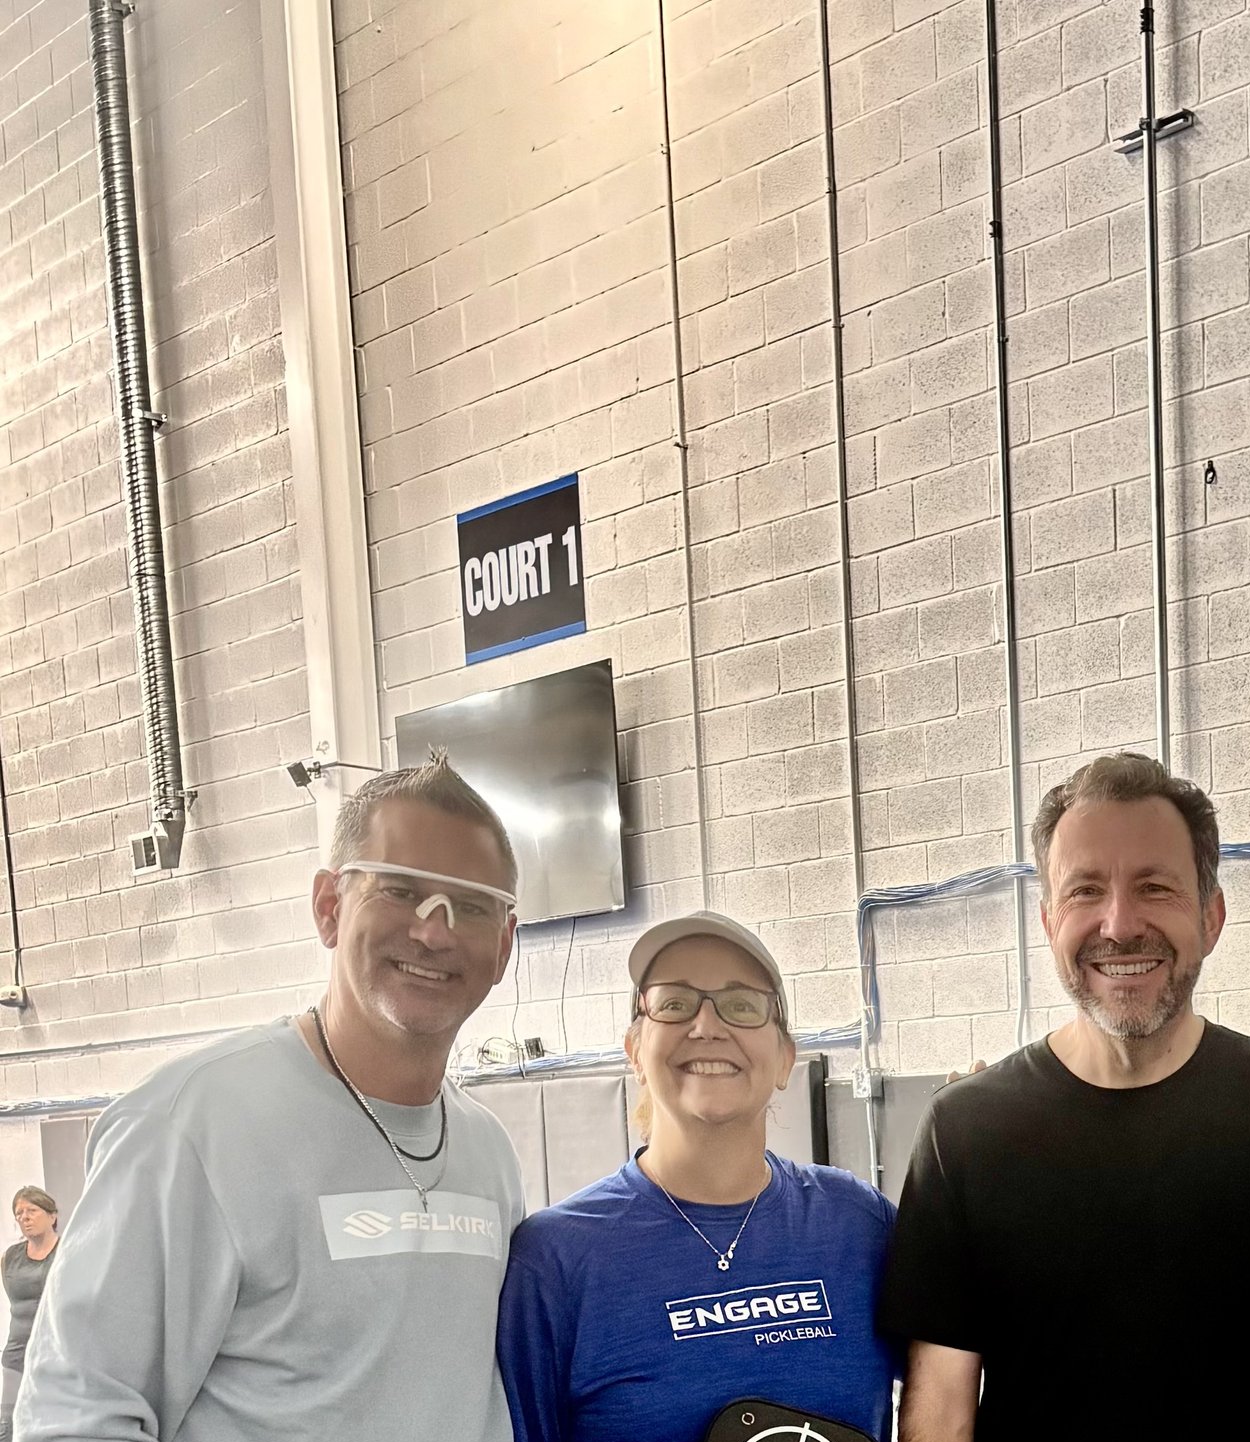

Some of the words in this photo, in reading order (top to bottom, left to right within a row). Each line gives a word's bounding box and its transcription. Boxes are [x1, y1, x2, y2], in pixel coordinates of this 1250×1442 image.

[464, 533, 553, 617] COURT
[562, 525, 578, 586] 1
[669, 1291, 822, 1331] ENGAGE
[755, 1326, 837, 1346] PICKLEBALL
